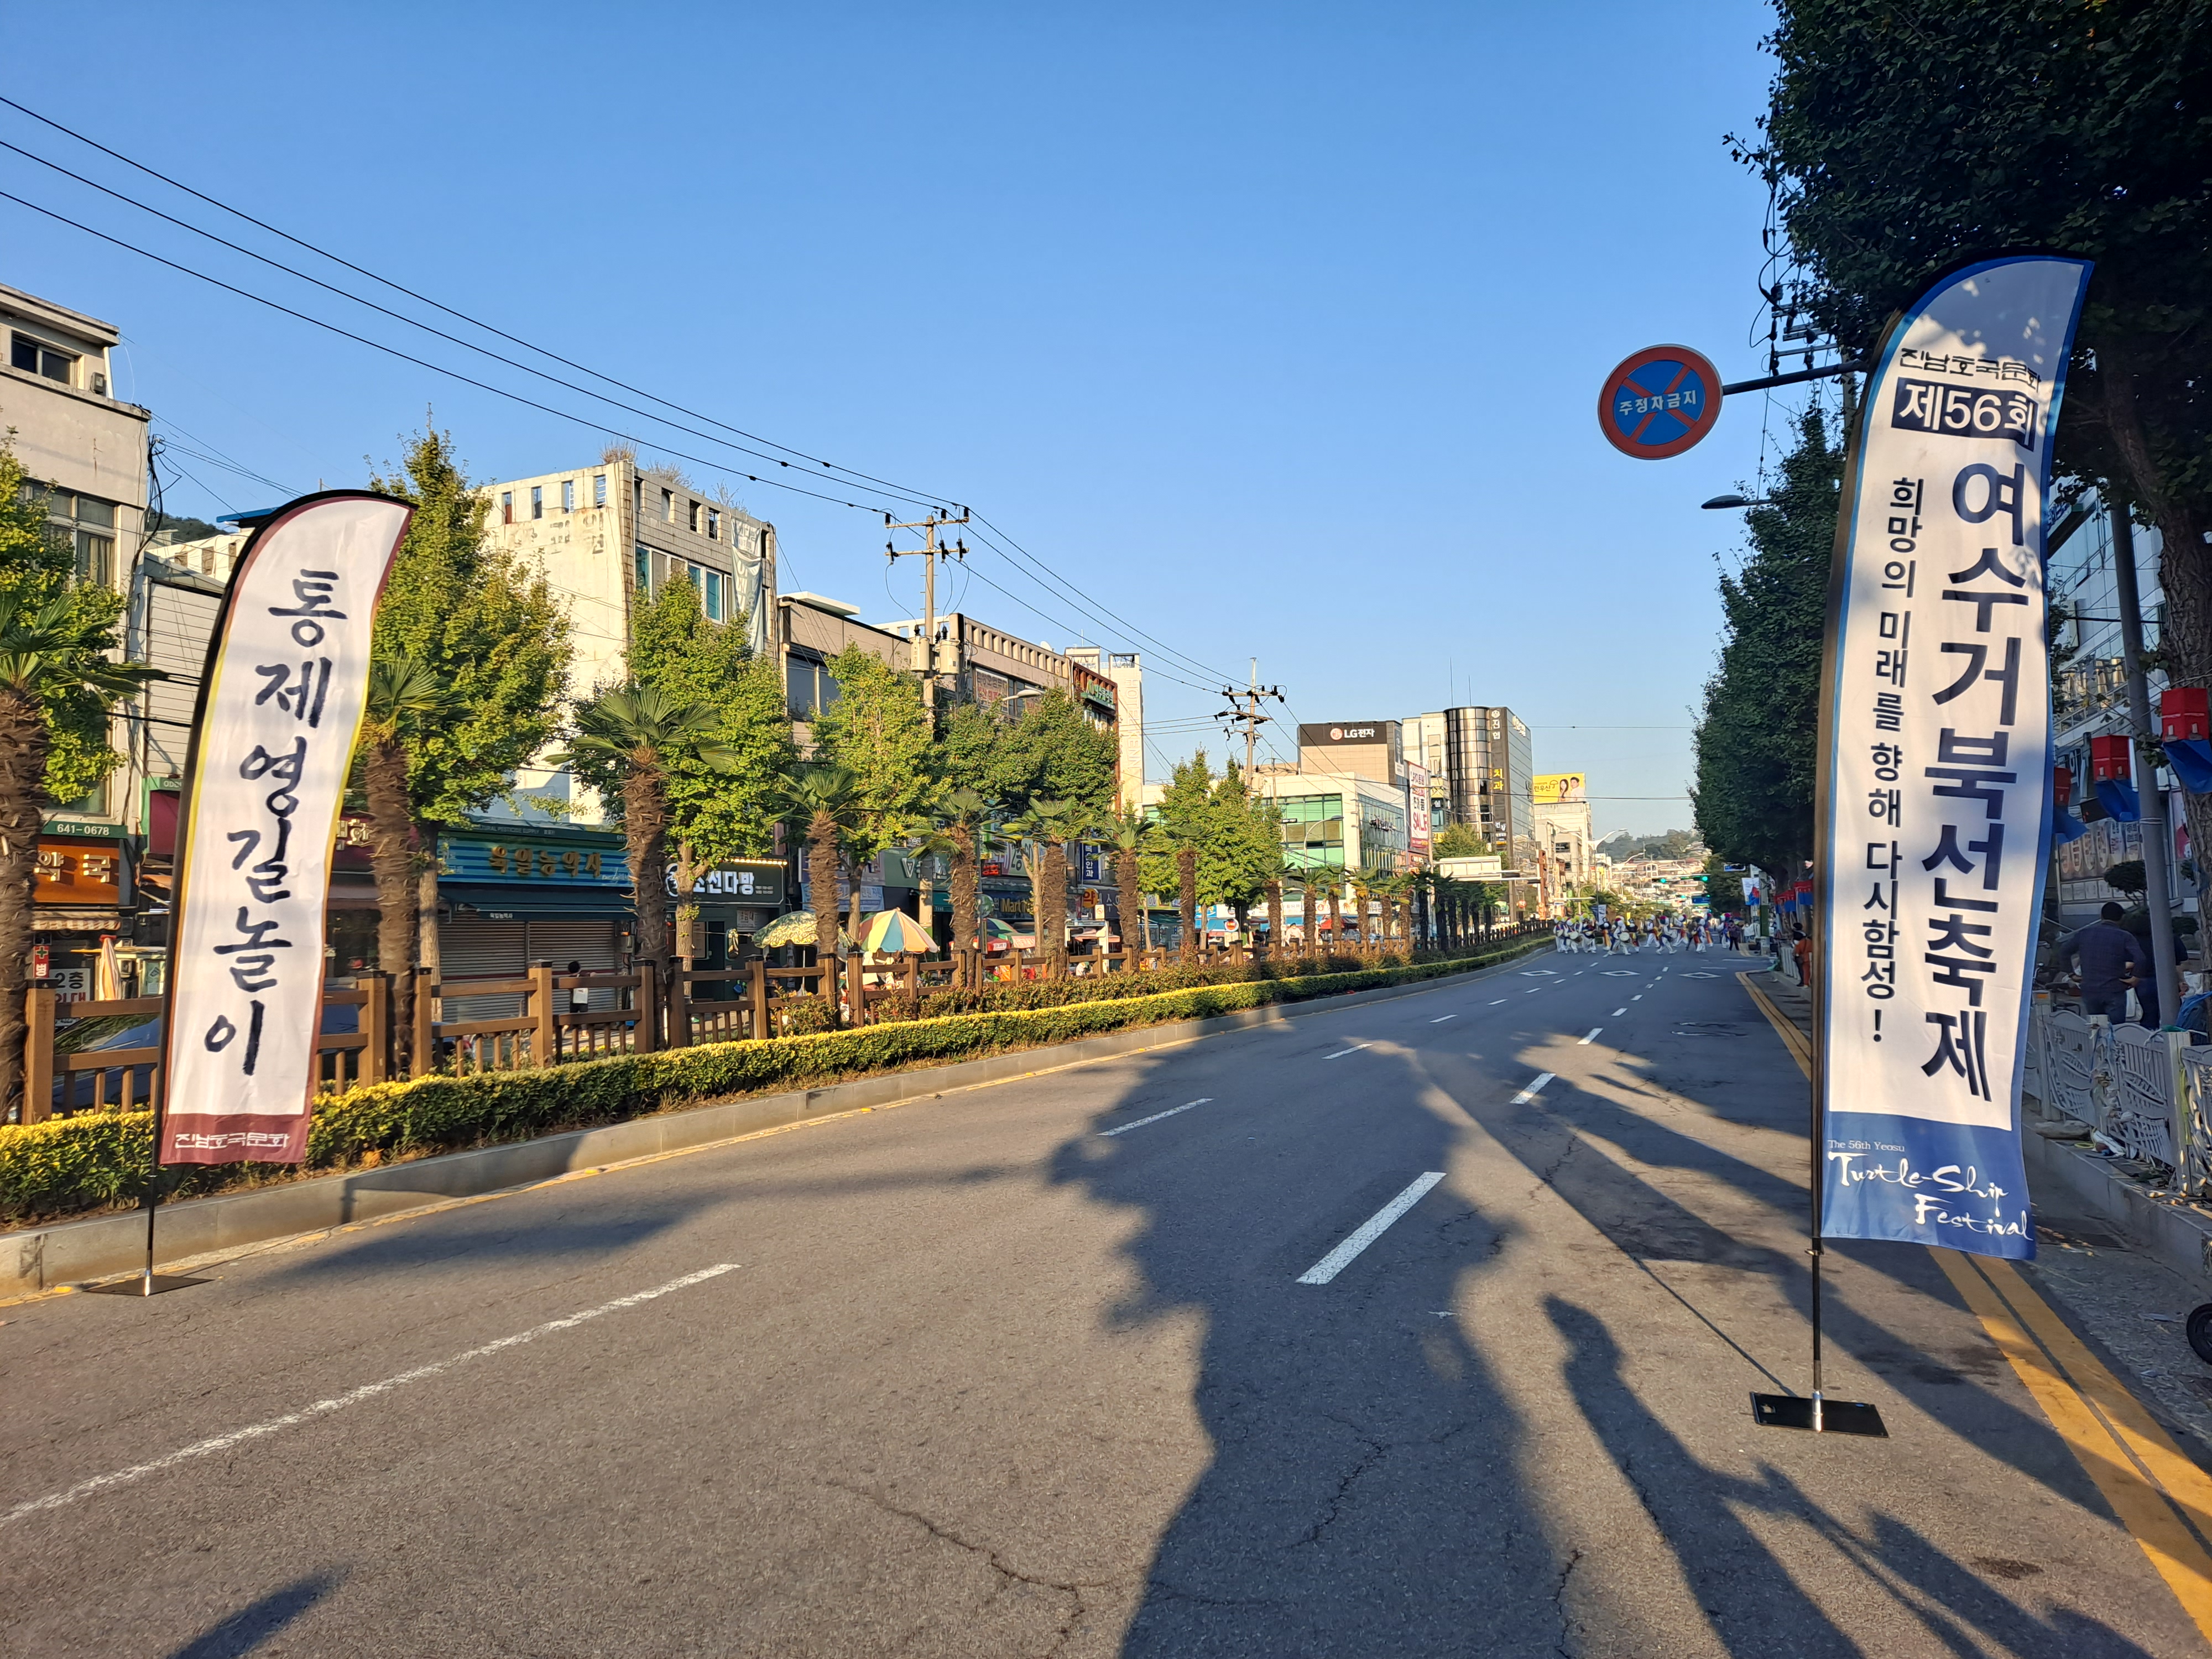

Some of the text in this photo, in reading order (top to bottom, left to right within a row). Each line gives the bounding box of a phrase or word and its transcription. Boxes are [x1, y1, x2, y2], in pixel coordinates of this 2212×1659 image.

[1898, 383, 2036, 446] 제56회
[1881, 477, 1924, 598] 희망의
[1872, 611, 1912, 732] 미래를
[1344, 728, 1375, 738] LG전자
[1493, 768, 1504, 791] 치과
[1868, 742, 1903, 828] 향해
[1921, 462, 2029, 1102] 여수거북선축제
[57, 823, 109, 836] 641-0678
[204, 568, 348, 1076] 통제영길놀이
[1413, 811, 1427, 831] SALE
[33, 851, 111, 883] 약국
[1083, 890, 1095, 905] 약
[55, 971, 84, 989] 2층
[175, 1132, 290, 1149] 진남호국문화
[1828, 1139, 1905, 1152] The 56th Yeosu
[1827, 1151, 2009, 1217] Turtle-Ship
[1913, 1193, 2034, 1241] Festival
